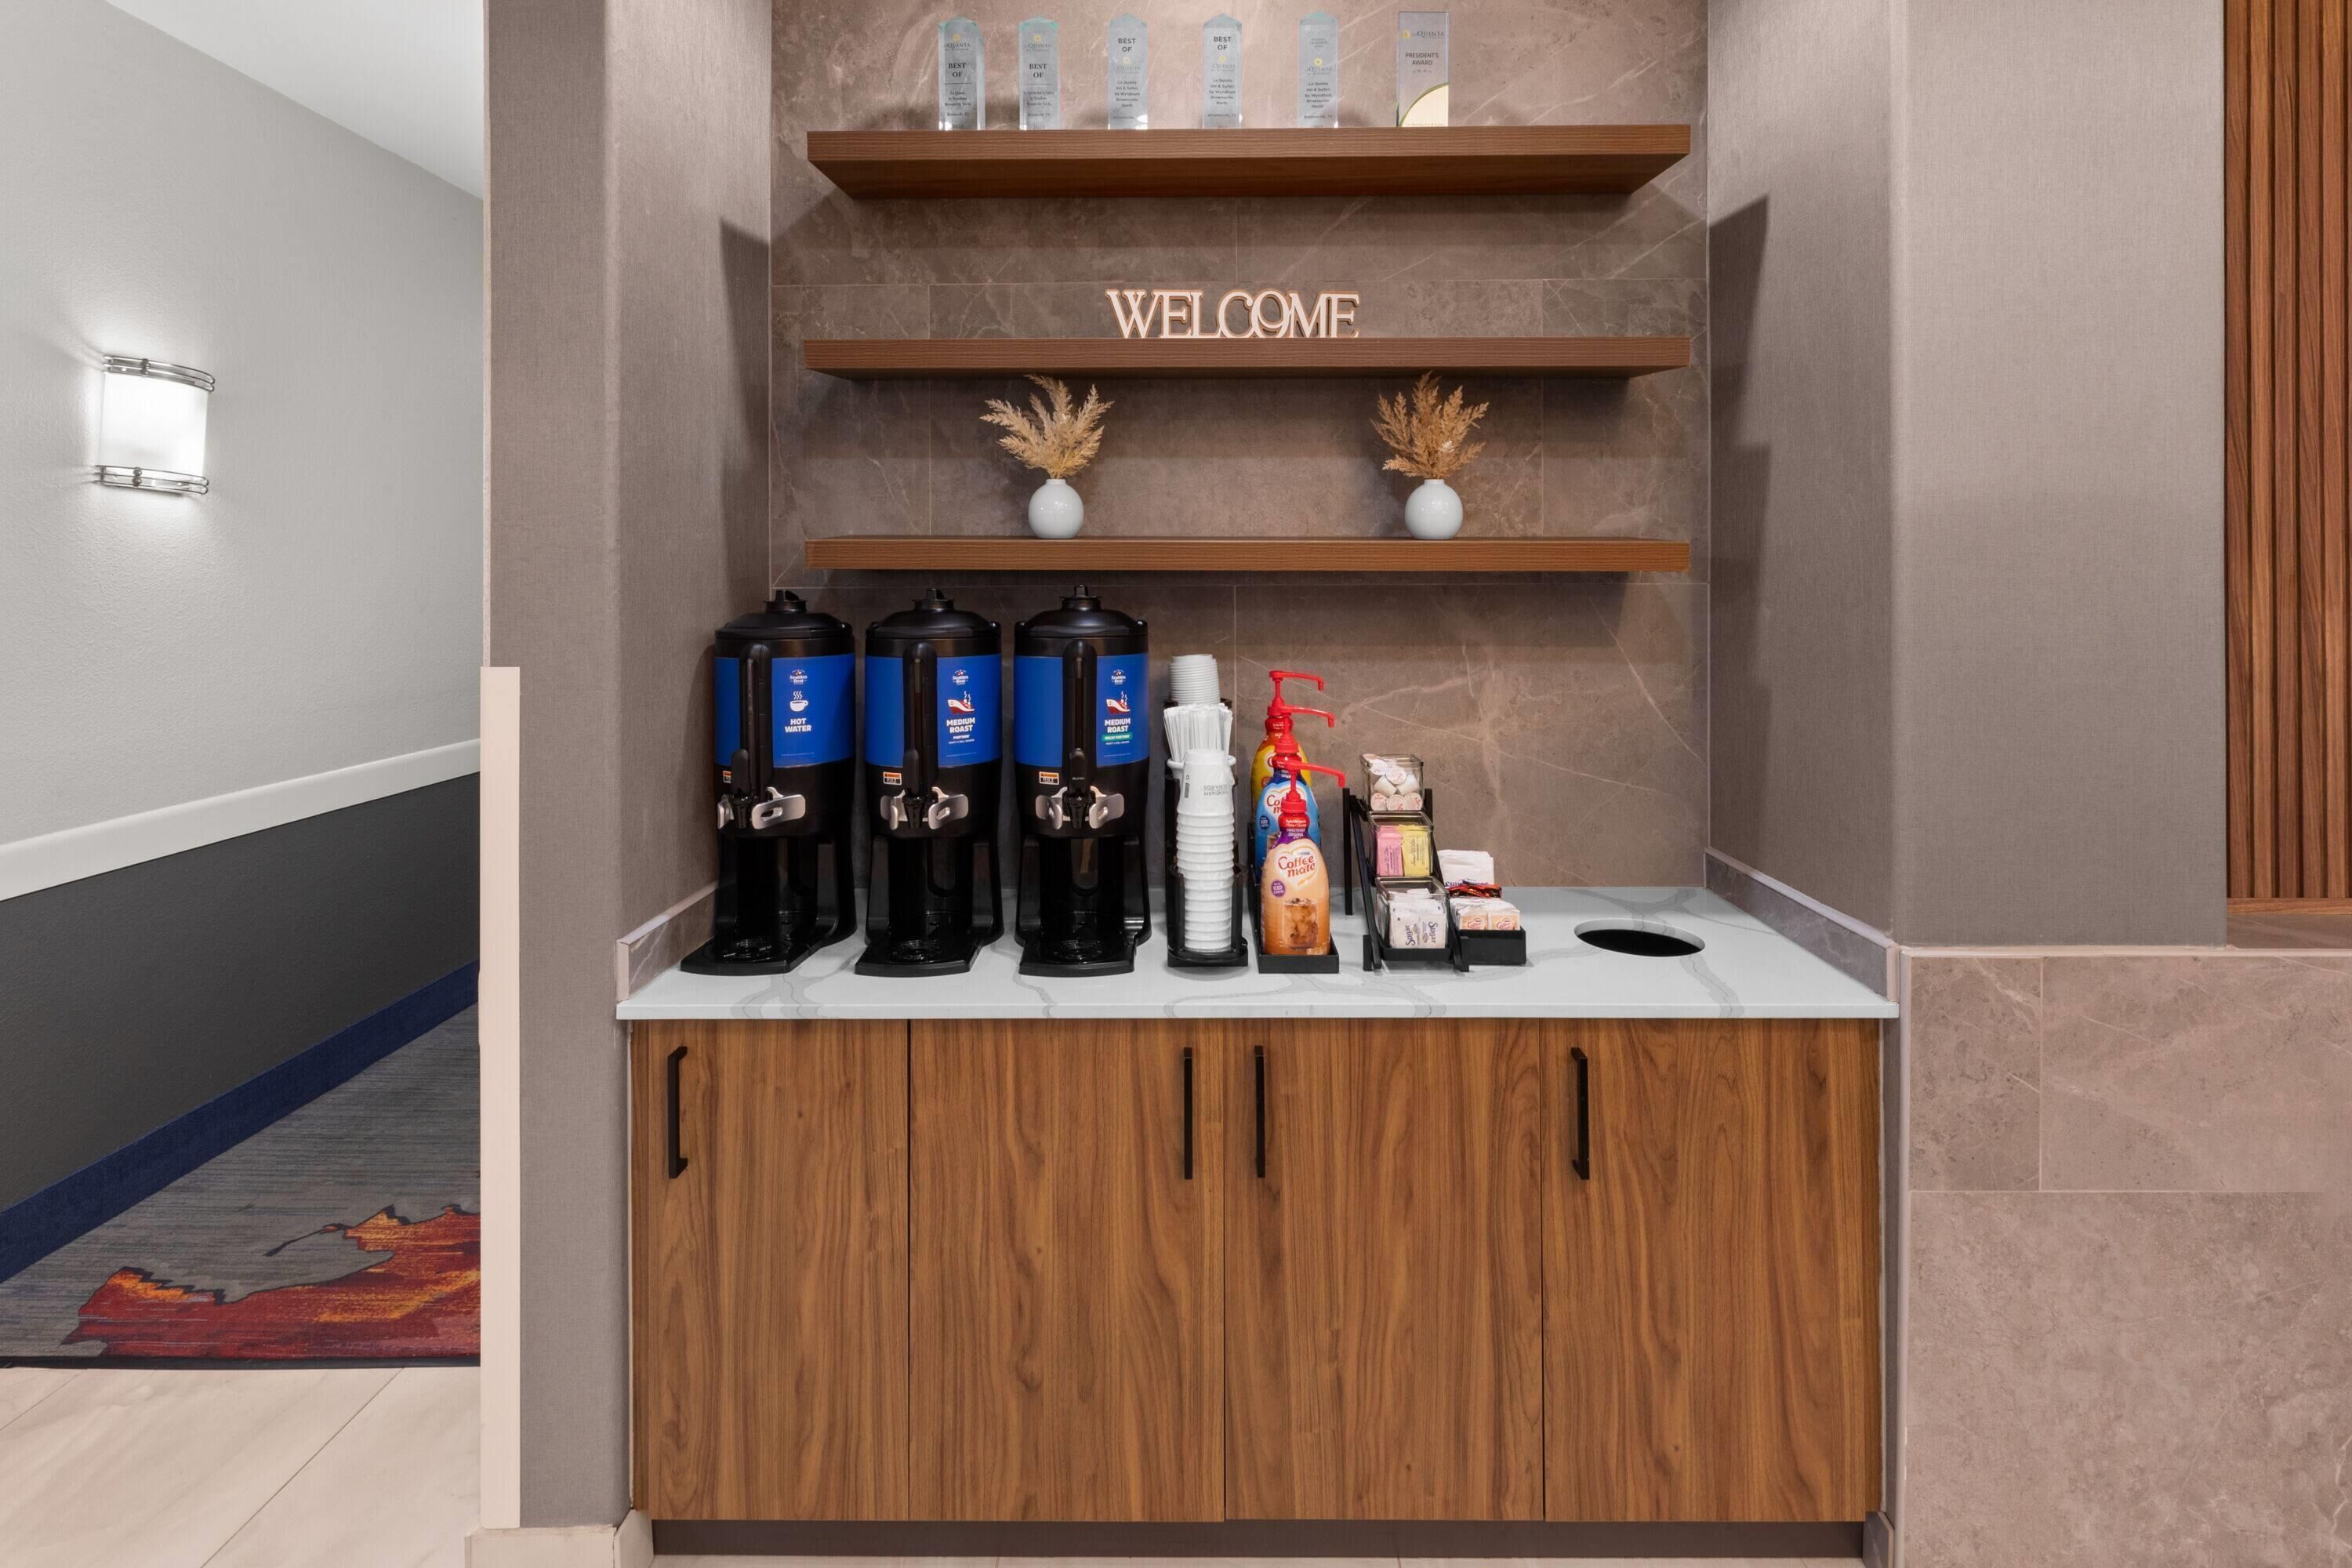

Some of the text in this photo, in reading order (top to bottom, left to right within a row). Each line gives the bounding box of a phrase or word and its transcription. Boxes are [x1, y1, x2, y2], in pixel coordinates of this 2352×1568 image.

[1105, 289, 1360, 339] WELCOME
[785, 724, 812, 733] WATER
[946, 717, 975, 727] MEDIUM
[949, 724, 974, 733] ROAST
[1104, 717, 1131, 726] MEDIUM
[1278, 855, 1314, 869] Coffee
[1287, 862, 1316, 877] mate
[1405, 924, 1416, 946] Sugar
[1428, 921, 1439, 943] Sugar
